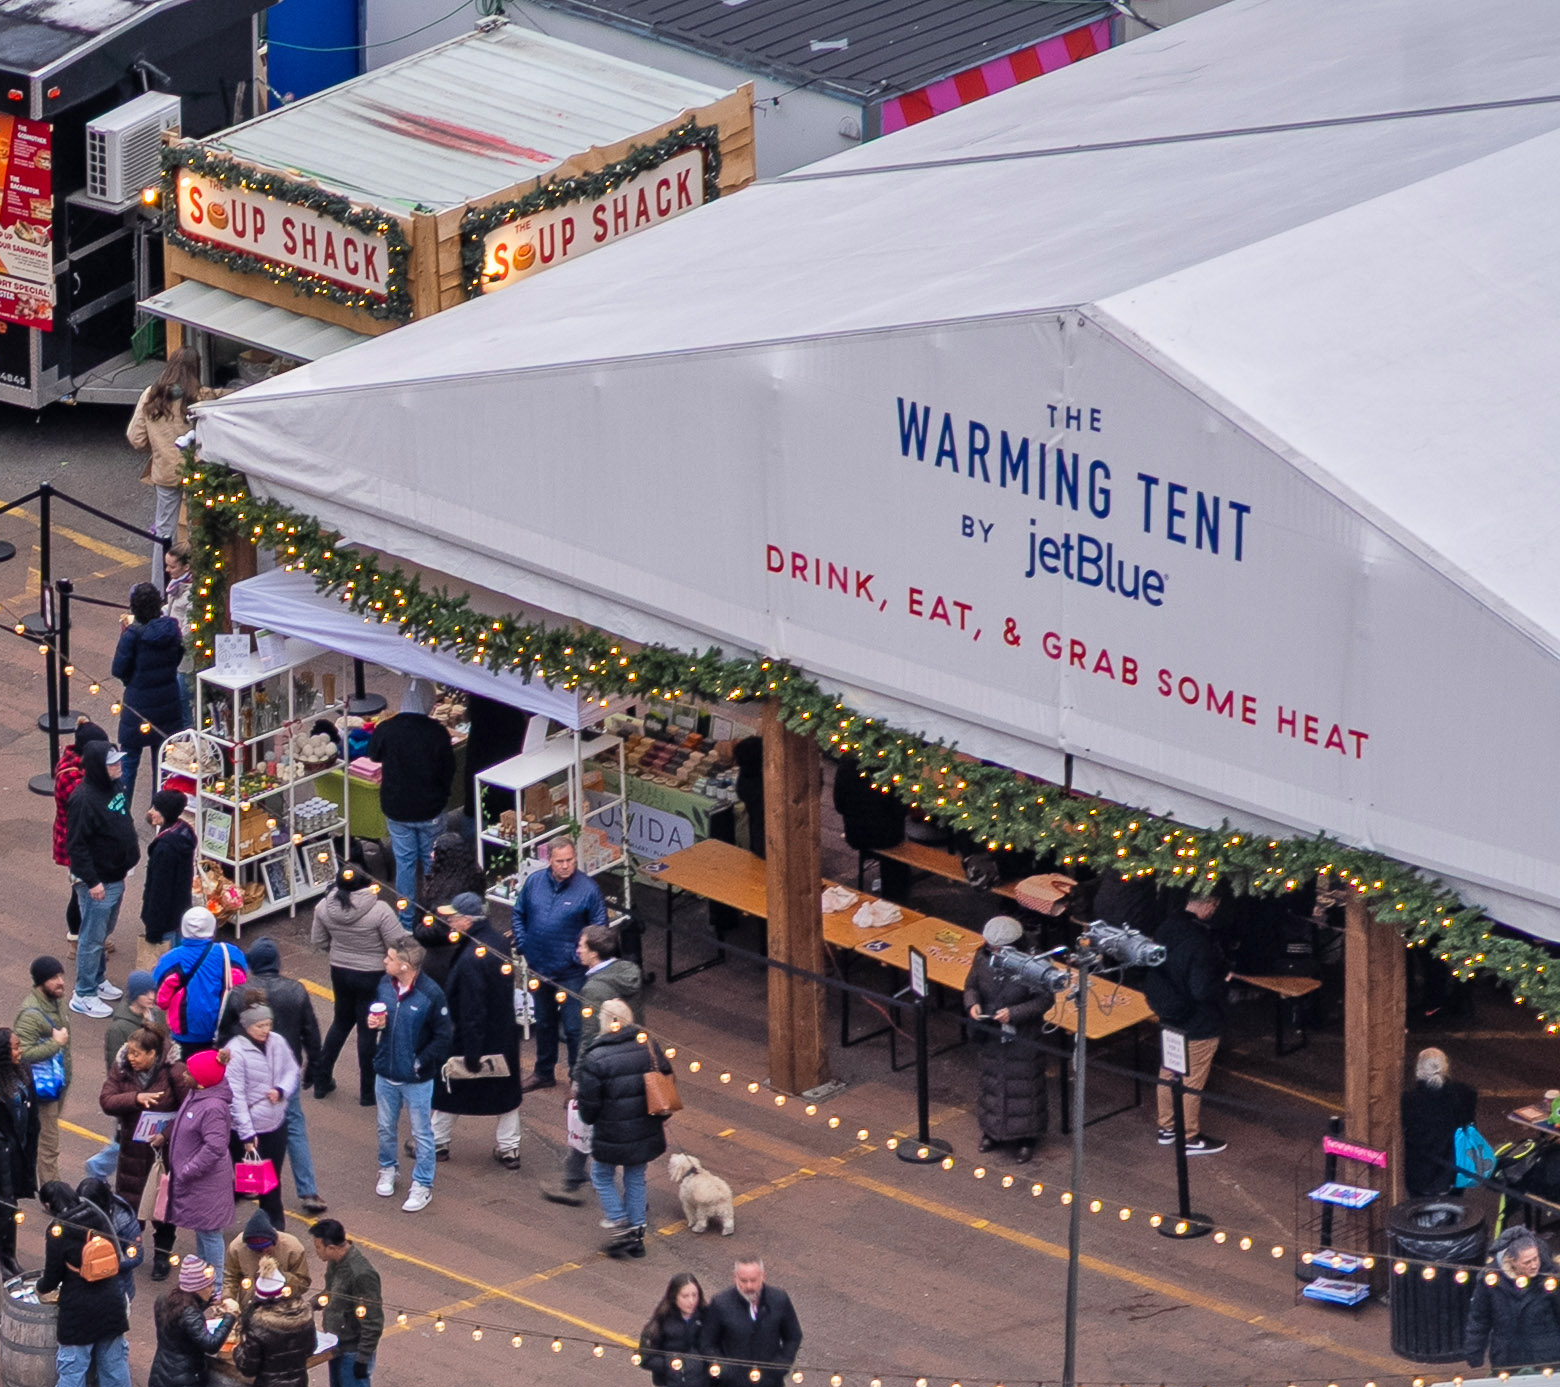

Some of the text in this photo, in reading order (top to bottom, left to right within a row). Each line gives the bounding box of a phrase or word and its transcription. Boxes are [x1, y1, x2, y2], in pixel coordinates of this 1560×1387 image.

[209, 178, 227, 192] THE
[592, 166, 694, 244] SHACK
[282, 216, 381, 284] SHACK
[514, 219, 533, 235] THE
[1046, 403, 1102, 433] THE
[896, 396, 1252, 562] WARMING TENT
[960, 513, 1161, 608] BY jetBlue
[766, 543, 1370, 760] DRINK, EAT, & GRAB SOME HEAT
